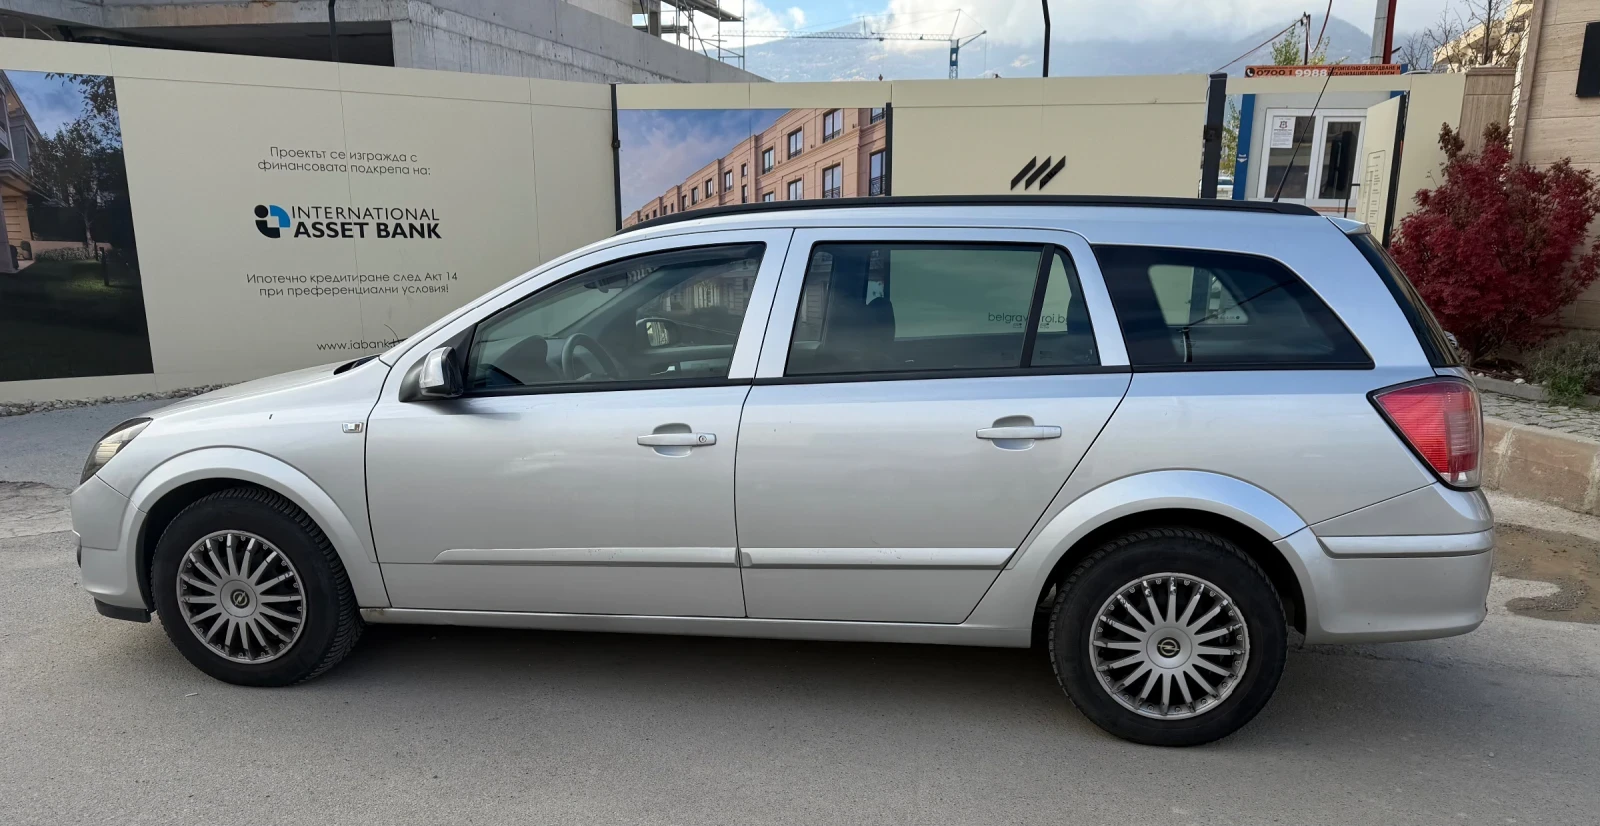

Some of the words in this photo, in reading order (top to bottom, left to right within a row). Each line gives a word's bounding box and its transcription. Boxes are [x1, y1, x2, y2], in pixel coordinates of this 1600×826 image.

[1295, 69, 1328, 77] 9988
[270, 147, 326, 159] Проектът
[330, 151, 346, 159] се
[349, 152, 407, 163] изгражда
[410, 153, 418, 162] с
[258, 160, 347, 173] финансовата
[350, 164, 410, 175] подкрепа
[413, 167, 431, 176] на:
[292, 206, 440, 221] INTERNATIONAL
[293, 221, 369, 239] ASSET
[376, 222, 442, 239] BANK
[246, 273, 307, 285] Ипотечно
[310, 273, 390, 286] кредитиране
[393, 273, 421, 283] след
[424, 272, 444, 282] Акт
[446, 271, 458, 281] 14
[259, 287, 284, 298] при
[287, 285, 399, 298] преференциални
[401, 284, 450, 296] условия!
